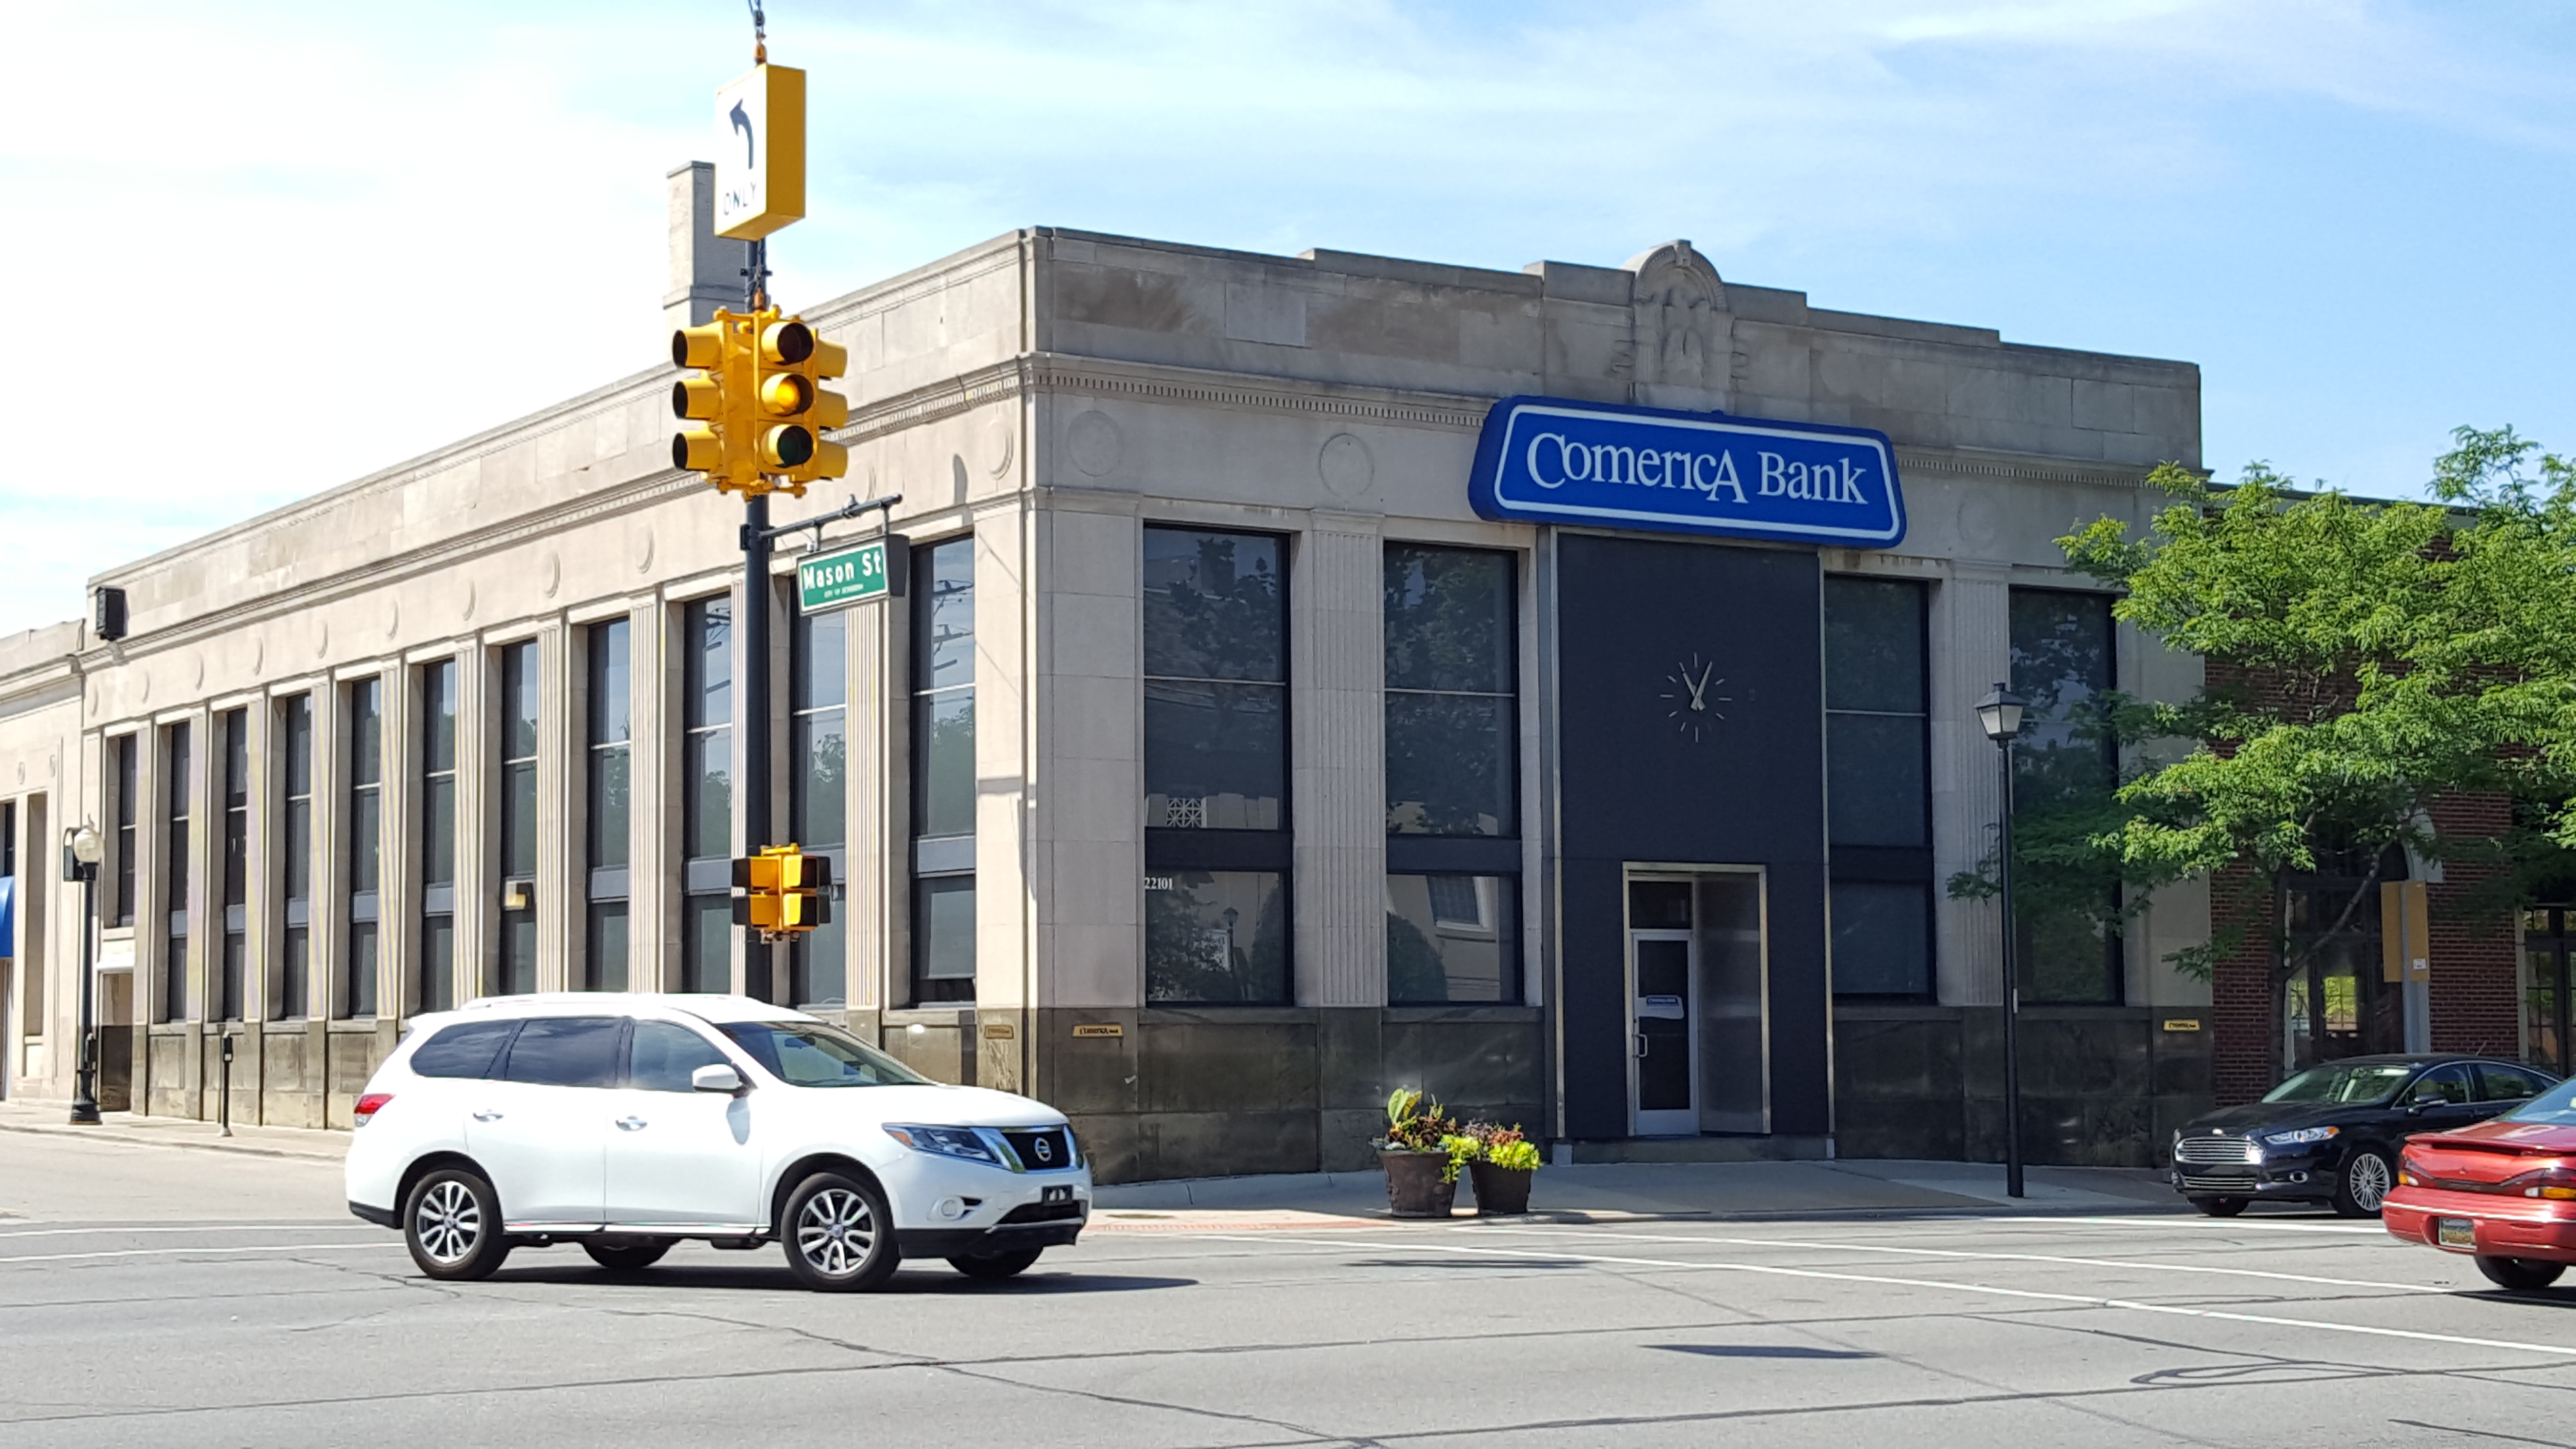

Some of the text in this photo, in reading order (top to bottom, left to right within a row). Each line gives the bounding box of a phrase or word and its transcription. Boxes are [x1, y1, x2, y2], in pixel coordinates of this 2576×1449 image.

[724, 181, 757, 216] ONLY
[1756, 451, 1868, 504] Bank
[803, 550, 882, 590] Mason St
[1144, 877, 1173, 890] 22101
